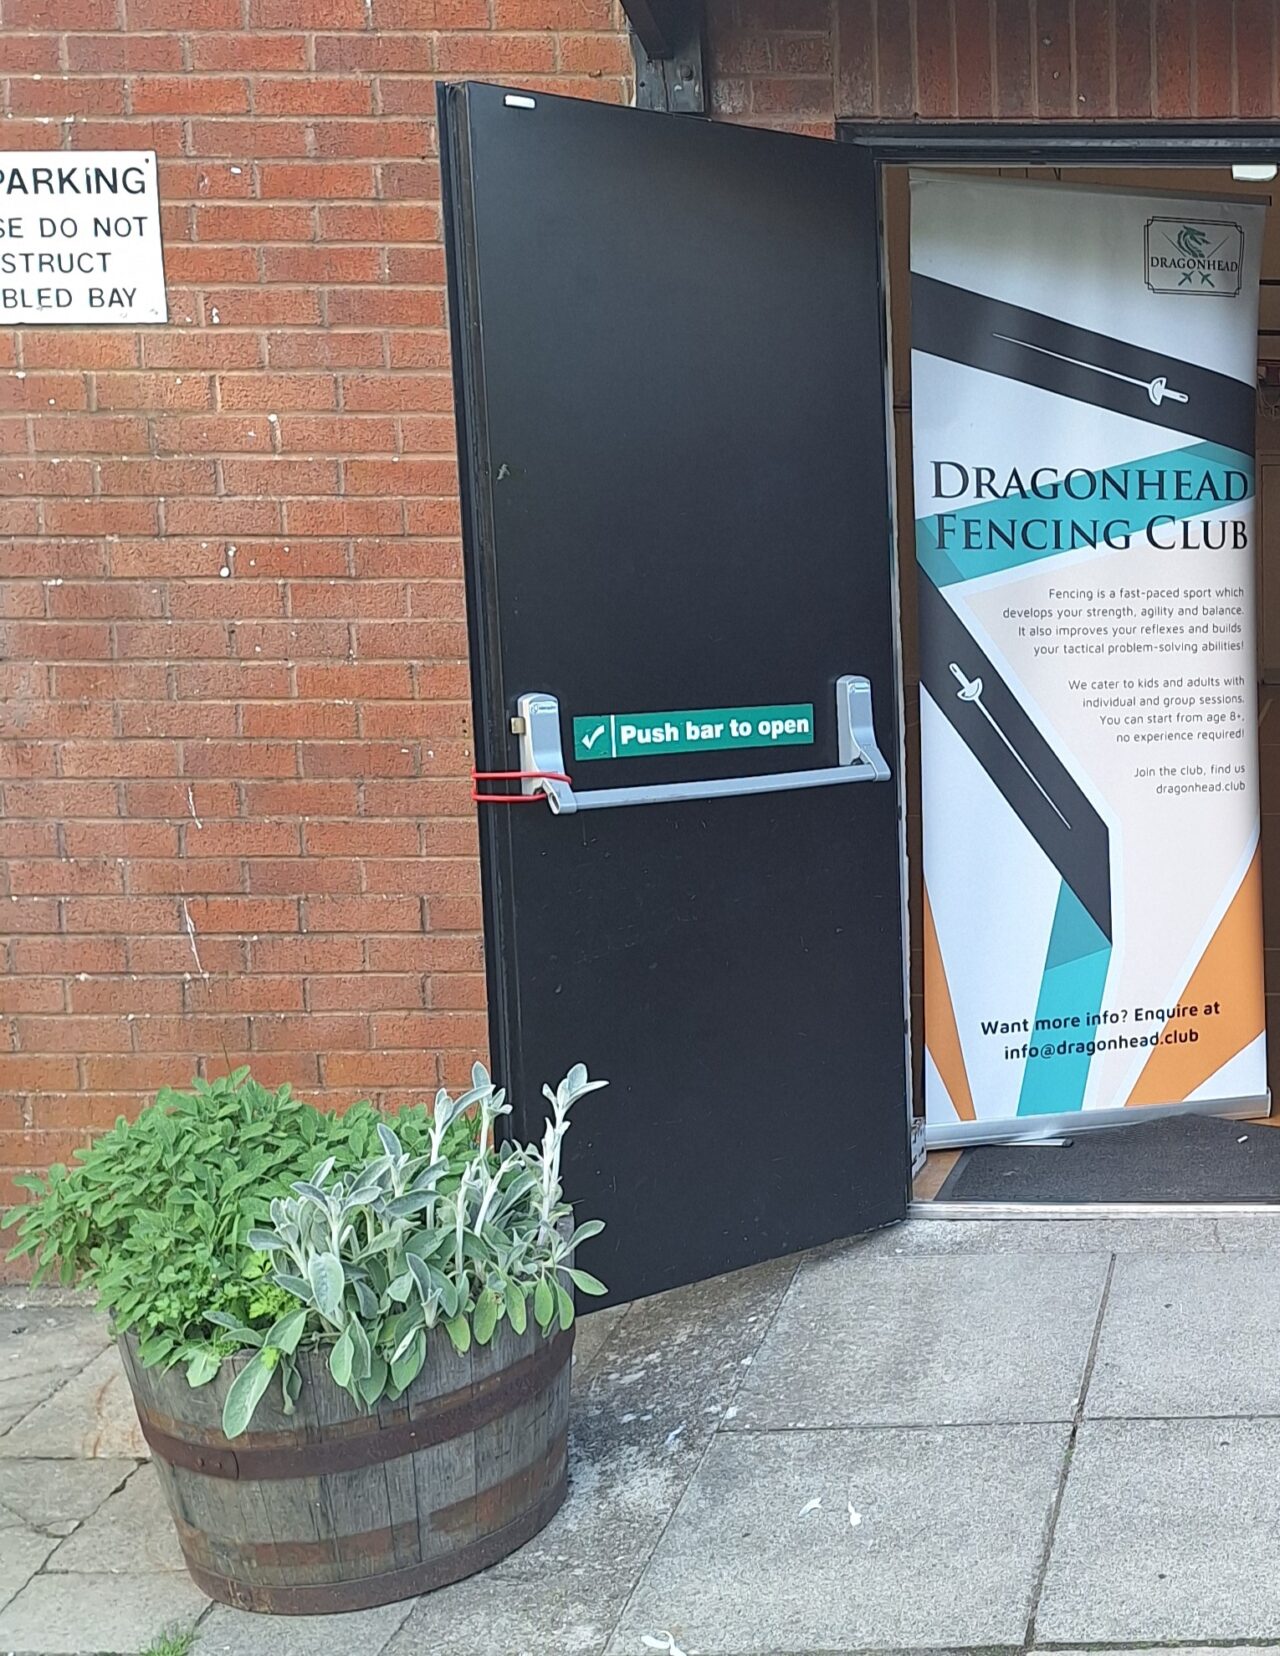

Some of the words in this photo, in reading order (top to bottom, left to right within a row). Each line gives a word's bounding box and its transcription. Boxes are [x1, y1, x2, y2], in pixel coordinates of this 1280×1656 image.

[39, 217, 78, 238] DO
[93, 216, 148, 238] NOT
[1, 252, 112, 273] STRUCT
[1150, 256, 1238, 272] DRAGONHEAD
[88, 287, 137, 308] BAY
[930, 461, 1249, 501] DRAGONHEAD
[935, 514, 1132, 551] FENCING
[1145, 514, 1249, 551] CLUB
[1049, 588, 1093, 601] Fencing
[1097, 588, 1106, 599] is
[1109, 589, 1116, 599] a
[1119, 587, 1180, 601] fast-paced
[1183, 588, 1211, 600] sport
[1215, 587, 1244, 598] which
[1002, 607, 1053, 620] develops
[1056, 609, 1082, 620] your
[1086, 606, 1137, 620] strength,
[1141, 606, 1174, 619] agility
[1177, 605, 1199, 617] and
[1202, 605, 1245, 616] balance.
[1018, 626, 1026, 637] It
[1029, 626, 1052, 637] also
[1055, 626, 1108, 638] improves
[1112, 625, 1137, 637] your
[1140, 623, 1185, 635] reflexes
[1188, 623, 1209, 634] and
[1212, 622, 1242, 634] builds
[1034, 645, 1059, 657] your
[1063, 643, 1104, 655] tactical
[1108, 641, 1198, 656] problem-solving
[1201, 641, 1244, 652] abilities!
[1068, 680, 1088, 690] We
[1091, 680, 1120, 690] cater
[1123, 679, 1134, 689] to
[1138, 677, 1159, 688] kids
[1163, 677, 1183, 687] and
[1187, 676, 1220, 687] adults
[1223, 676, 1245, 686] with
[1082, 696, 1136, 708] individual
[1139, 696, 1160, 707] and
[1163, 697, 1196, 708] group
[1099, 715, 1121, 725] You
[1124, 716, 1144, 725] can
[1147, 713, 1172, 724] start
[1176, 712, 1203, 723] from
[1206, 713, 1227, 724] age
[620, 722, 679, 745] Push
[686, 721, 724, 741] bar
[729, 718, 751, 737] to
[757, 718, 810, 739] open
[1116, 733, 1130, 743] no
[1133, 731, 1194, 744] experience
[1197, 728, 1245, 742] required!
[1134, 767, 1156, 778] Join
[1159, 766, 1177, 776] the
[1180, 765, 1207, 777] club,
[1210, 764, 1231, 775] find
[1234, 764, 1246, 774] us
[1156, 780, 1246, 796] dragonhead.club
[980, 1018, 1030, 1035] Want
[1034, 1015, 1081, 1031] more
[1086, 1009, 1129, 1027] info?
[1134, 1002, 1199, 1023] Enquire
[1203, 1001, 1221, 1016] at
[1004, 1028, 1199, 1060] info@dragonhead.club
